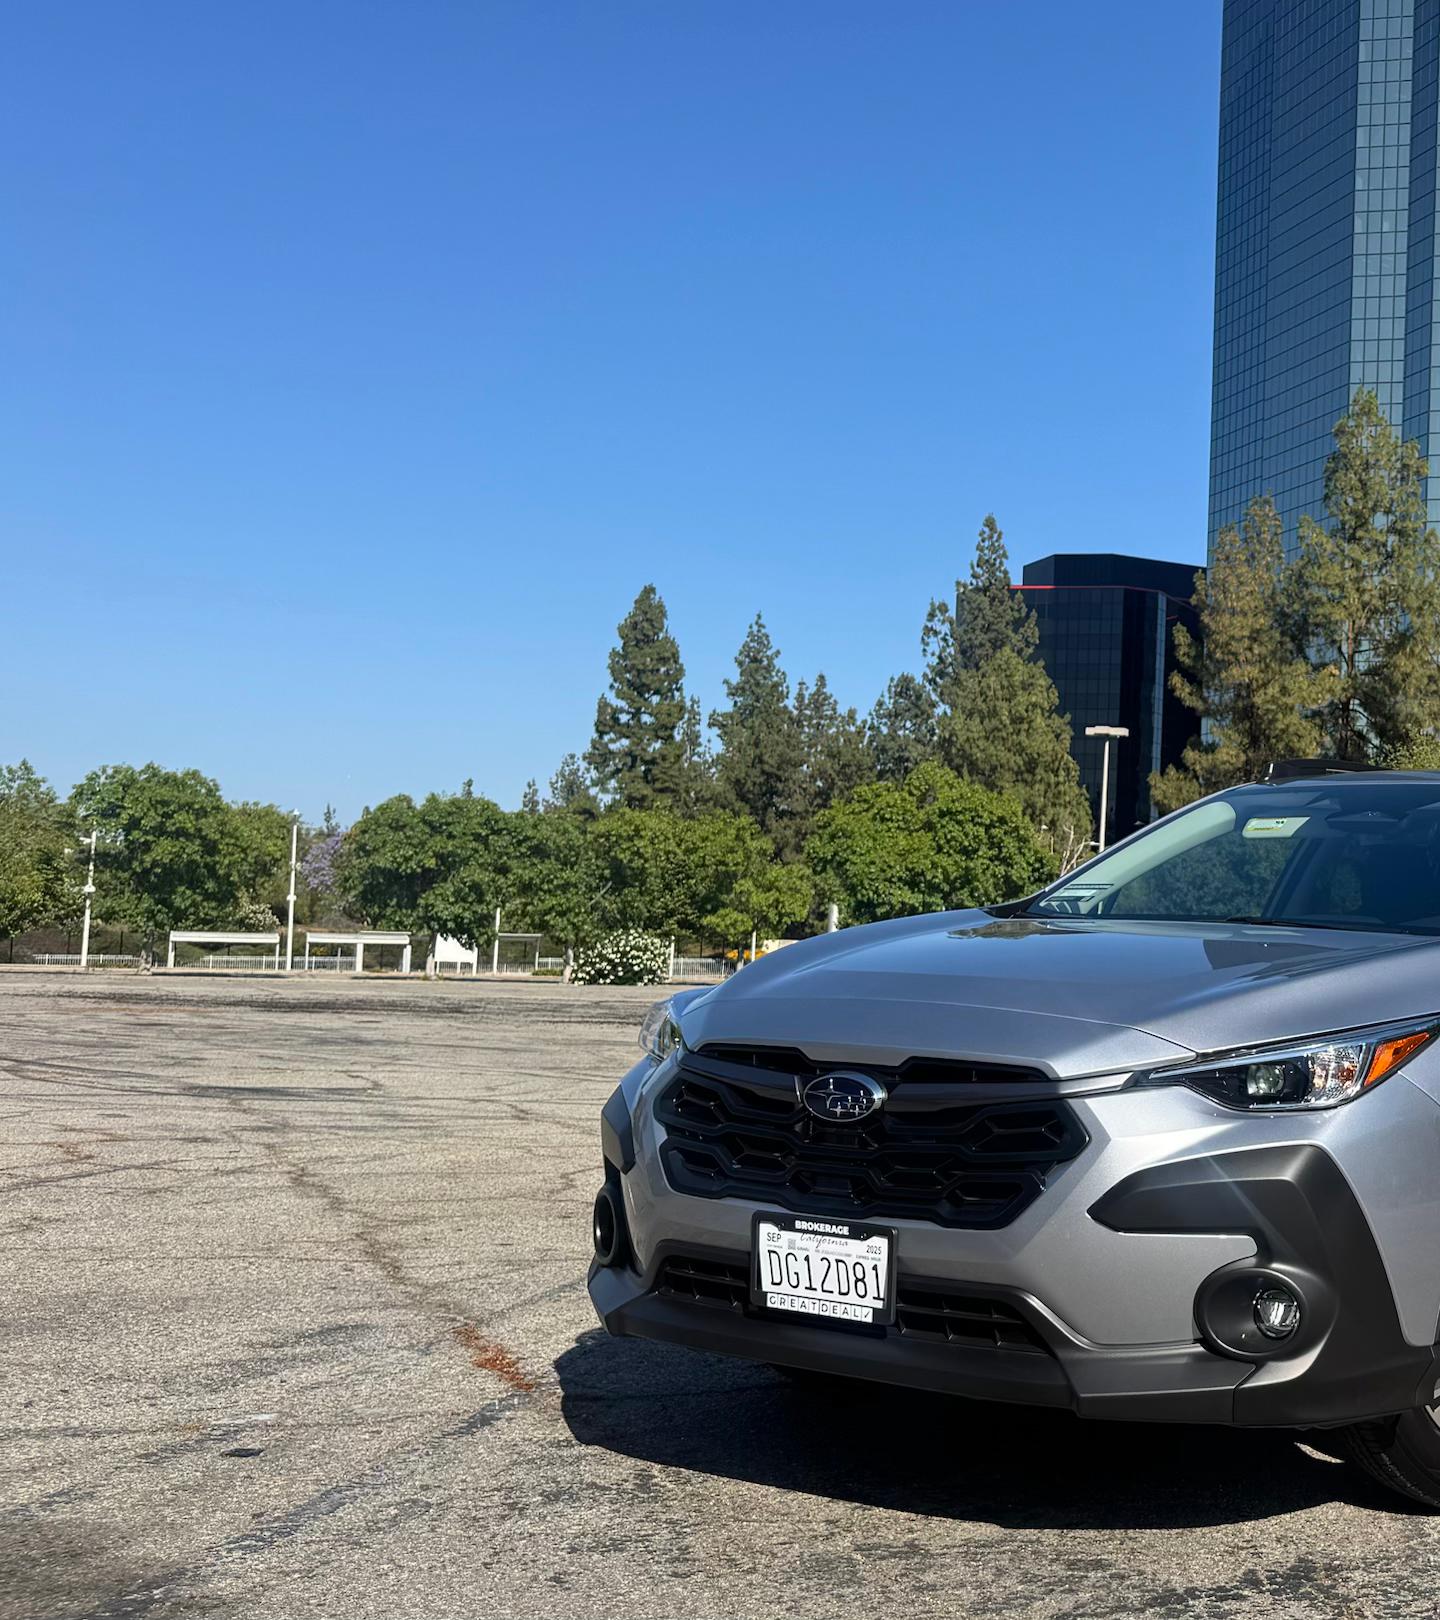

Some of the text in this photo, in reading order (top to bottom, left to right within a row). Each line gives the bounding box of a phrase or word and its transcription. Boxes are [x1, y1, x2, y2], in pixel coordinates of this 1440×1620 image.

[795, 1220, 849, 1235] BROKERAGE
[766, 1232, 782, 1243] SEP
[800, 1233, 849, 1248] California
[866, 1245, 882, 1255] 2025
[768, 1249, 885, 1301] DG12D81
